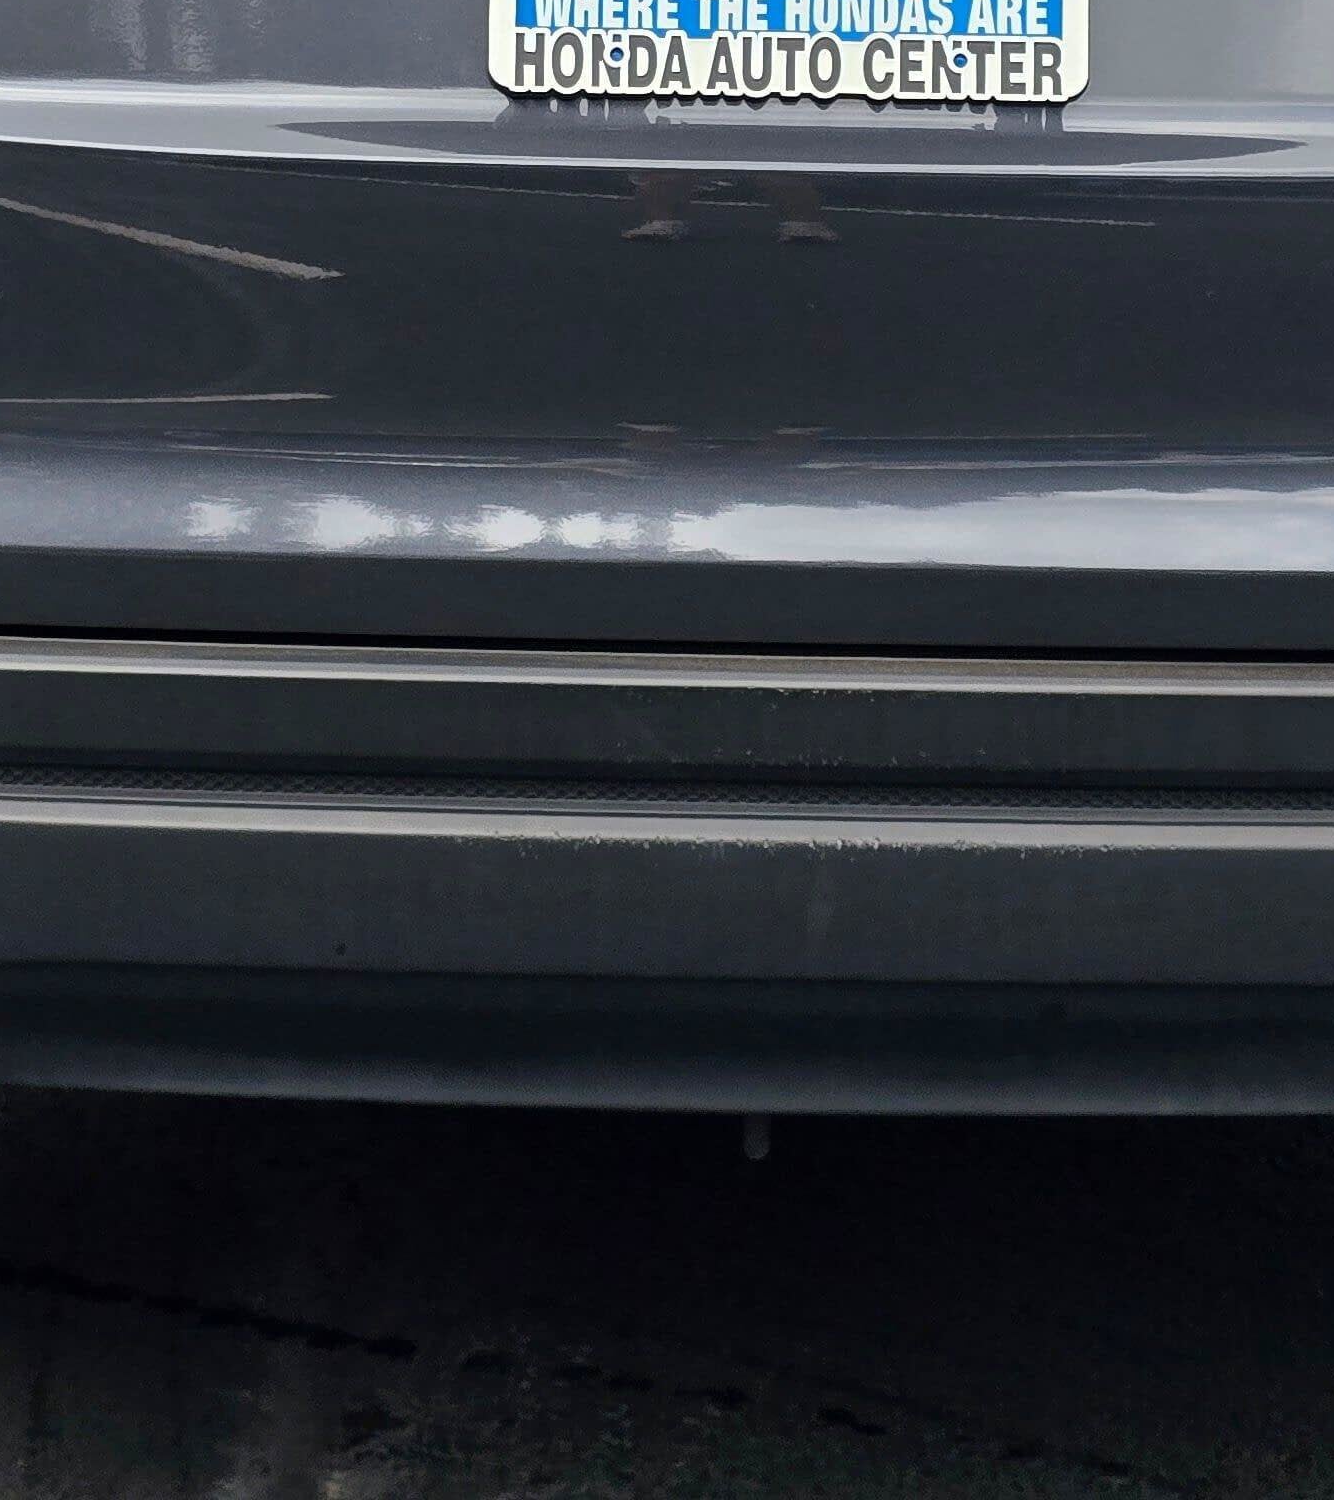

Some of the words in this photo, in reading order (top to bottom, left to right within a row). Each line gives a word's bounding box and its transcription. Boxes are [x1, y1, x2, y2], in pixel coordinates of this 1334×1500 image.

[513, 32, 692, 91] HONDA
[707, 34, 841, 93] AUTO
[862, 37, 1064, 96] CENTER
